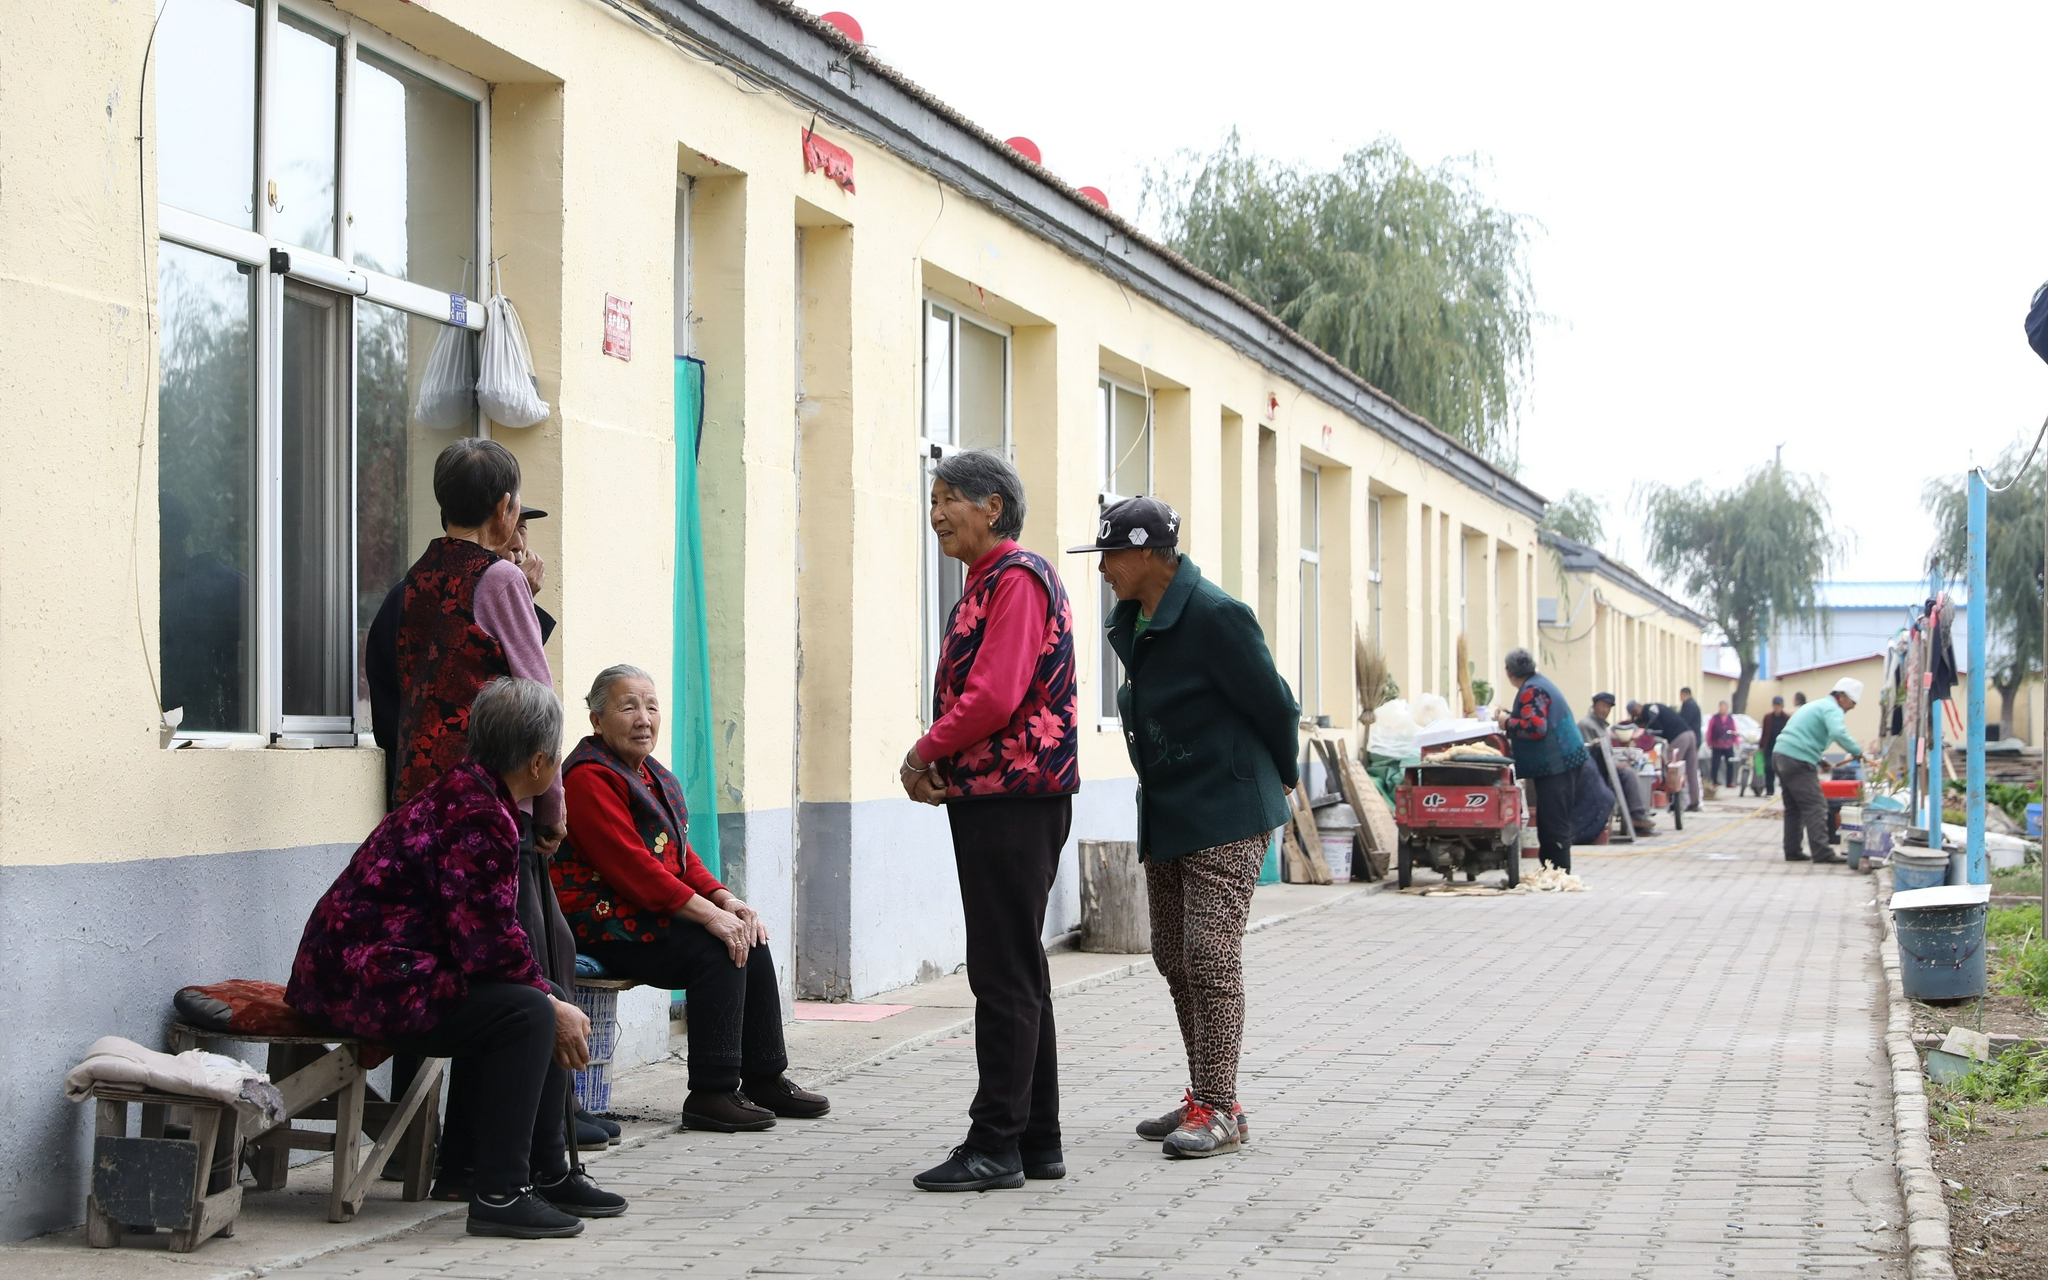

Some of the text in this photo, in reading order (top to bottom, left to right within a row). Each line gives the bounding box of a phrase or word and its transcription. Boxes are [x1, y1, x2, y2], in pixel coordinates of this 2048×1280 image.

[608, 313, 629, 332] 共产党员户
